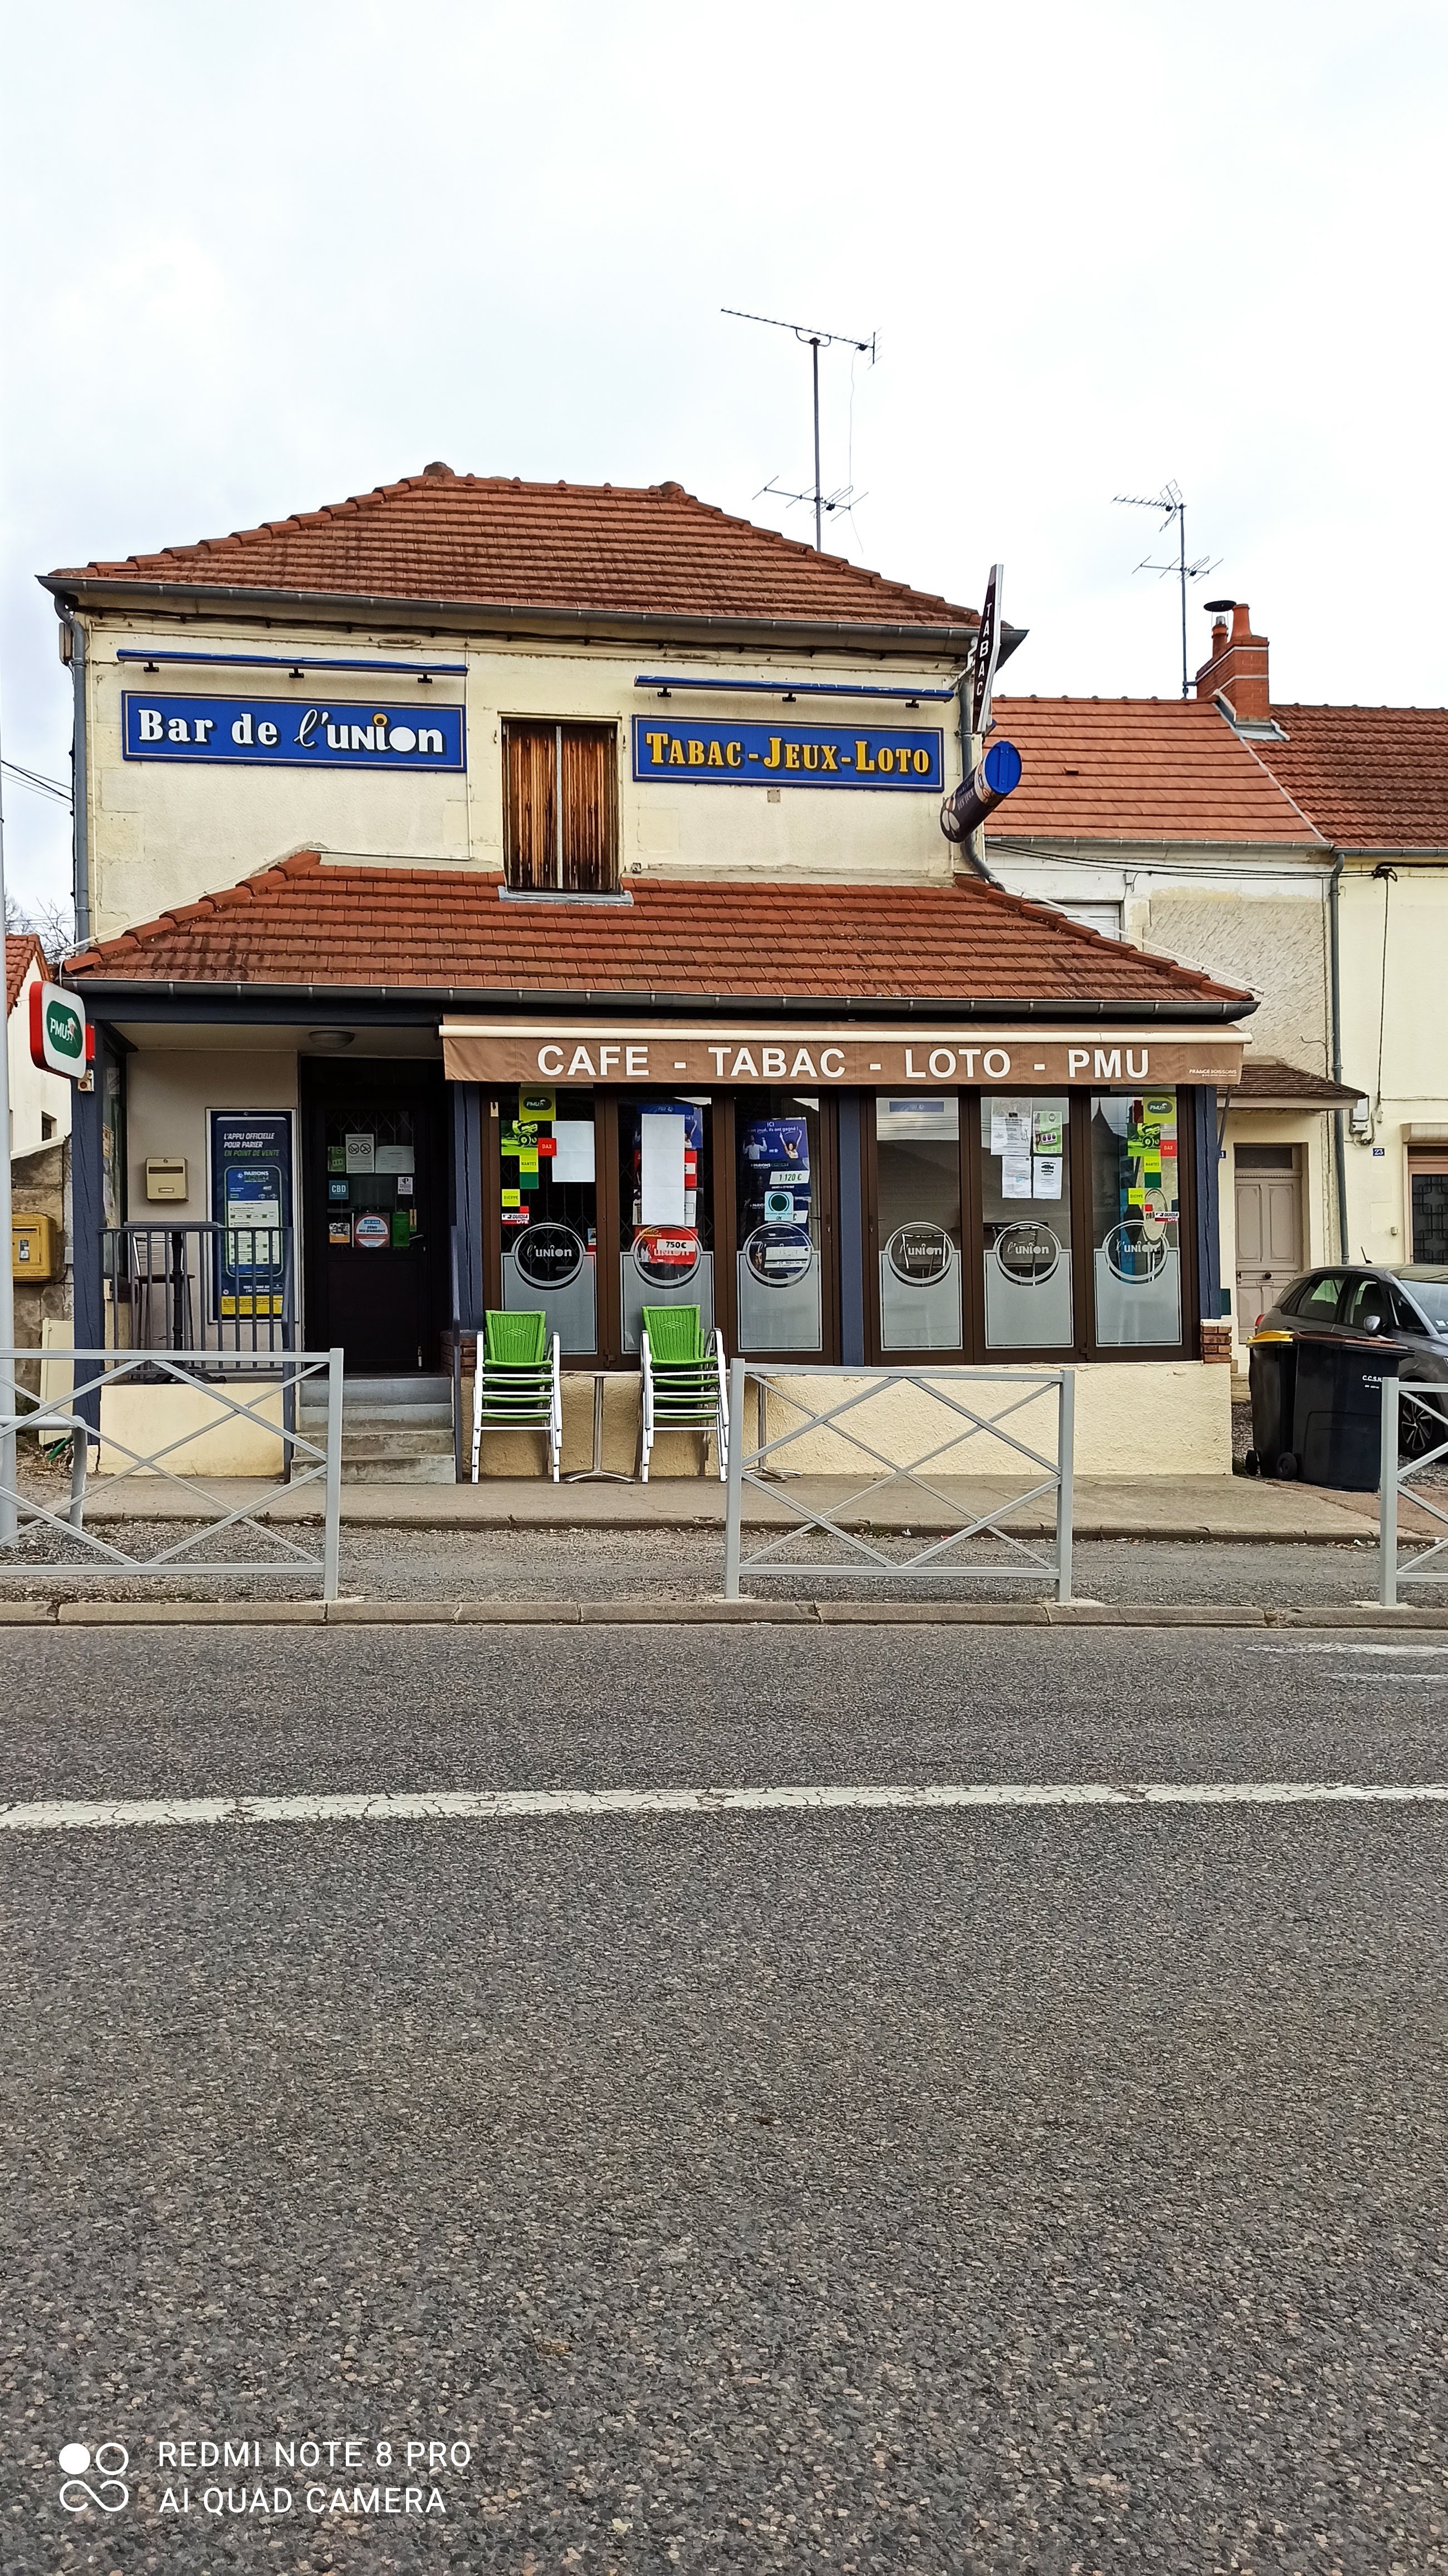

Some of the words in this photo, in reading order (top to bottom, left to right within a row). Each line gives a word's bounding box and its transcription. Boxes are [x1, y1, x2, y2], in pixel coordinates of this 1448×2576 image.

[976, 602, 992, 696] TABAC
[138, 709, 214, 743] Bar
[231, 713, 278, 746] de
[50, 1017, 68, 1040] PMU
[537, 1045, 649, 1076] CAFE
[708, 1046, 846, 1078] TABAC
[905, 1048, 1011, 1079] LOTO
[1068, 1048, 1149, 1079] PMU
